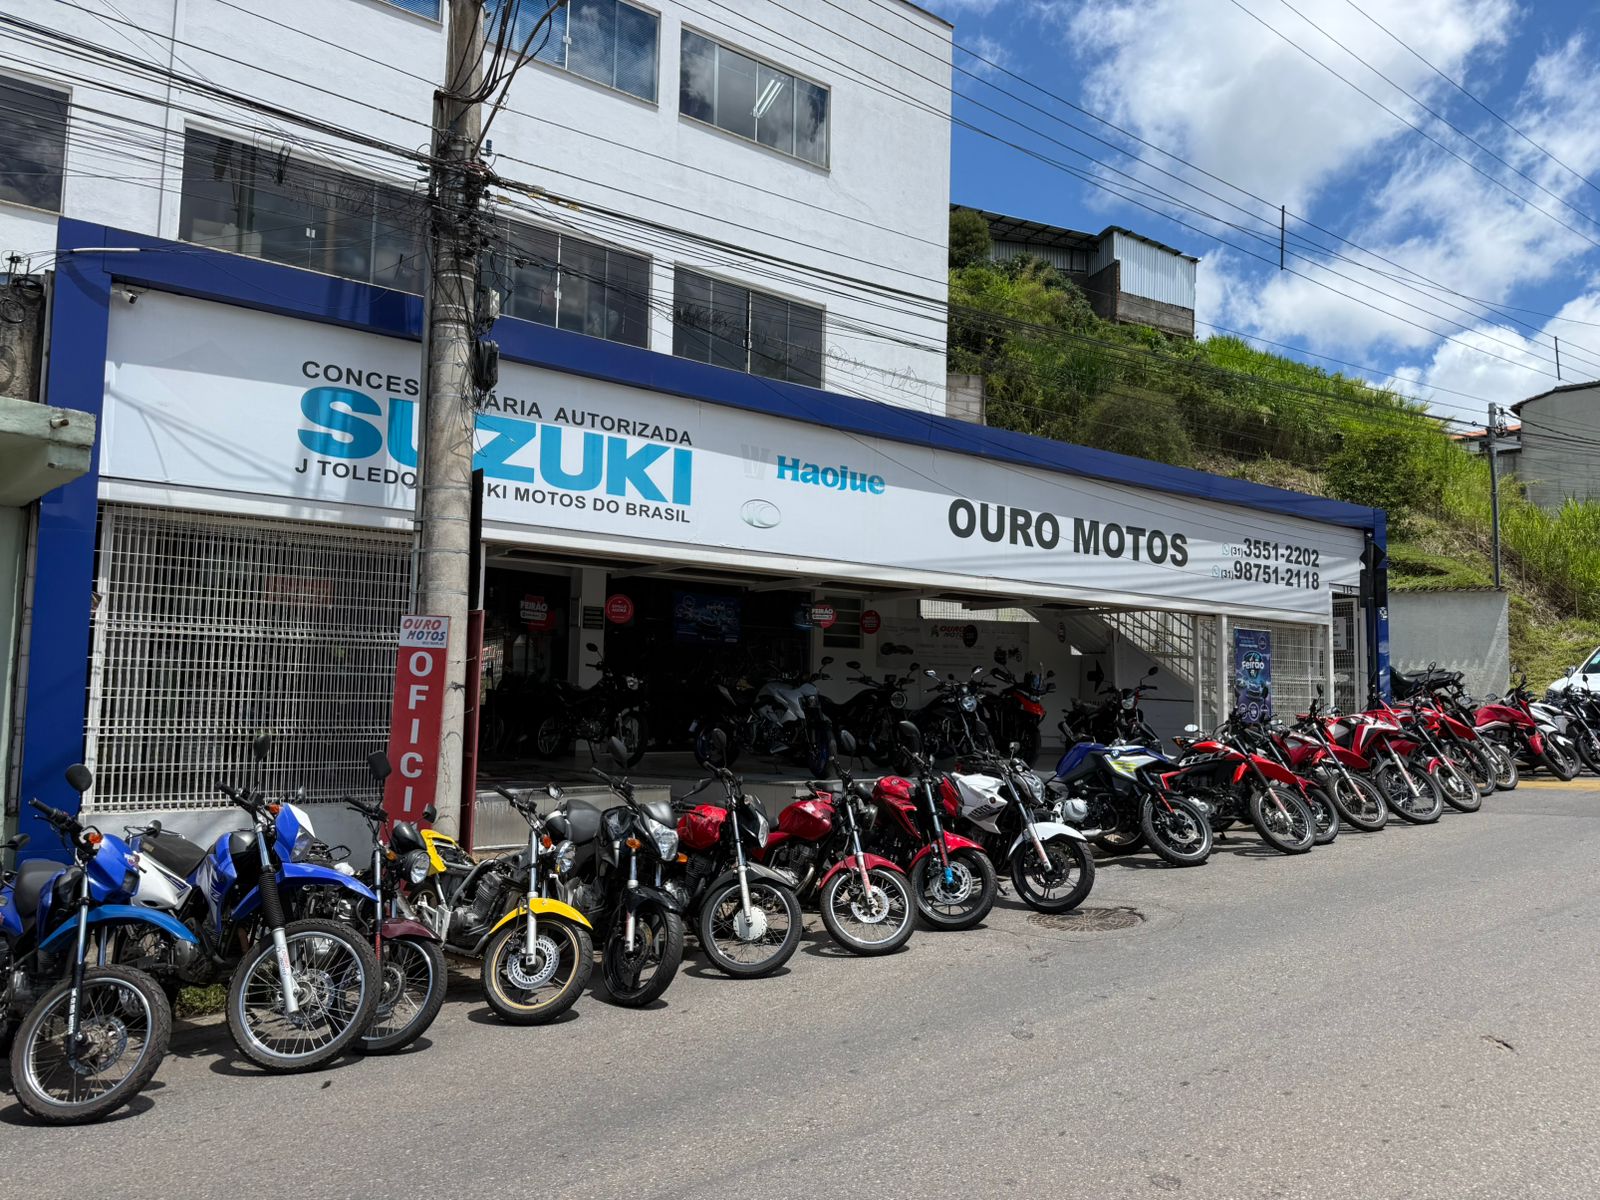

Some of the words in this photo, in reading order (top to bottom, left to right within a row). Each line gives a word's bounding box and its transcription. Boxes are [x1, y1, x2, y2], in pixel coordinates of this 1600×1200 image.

[302, 361, 543, 419] CONCESÁRIA
[554, 407, 693, 446] AUTORIZADA
[295, 458, 308, 474] J
[317, 460, 418, 488] TOLEDO
[514, 486, 586, 509] MOTOS
[592, 497, 620, 514] DO
[625, 502, 690, 523] BRASIL
[776, 454, 886, 495] Haojue
[948, 498, 1060, 550] OURO
[1073, 517, 1189, 567] MOTOS
[403, 618, 442, 630] OURO
[406, 630, 446, 641] MOTOS
[811, 607, 833, 615] FEIRÃO
[393, 651, 434, 829] OFICI
